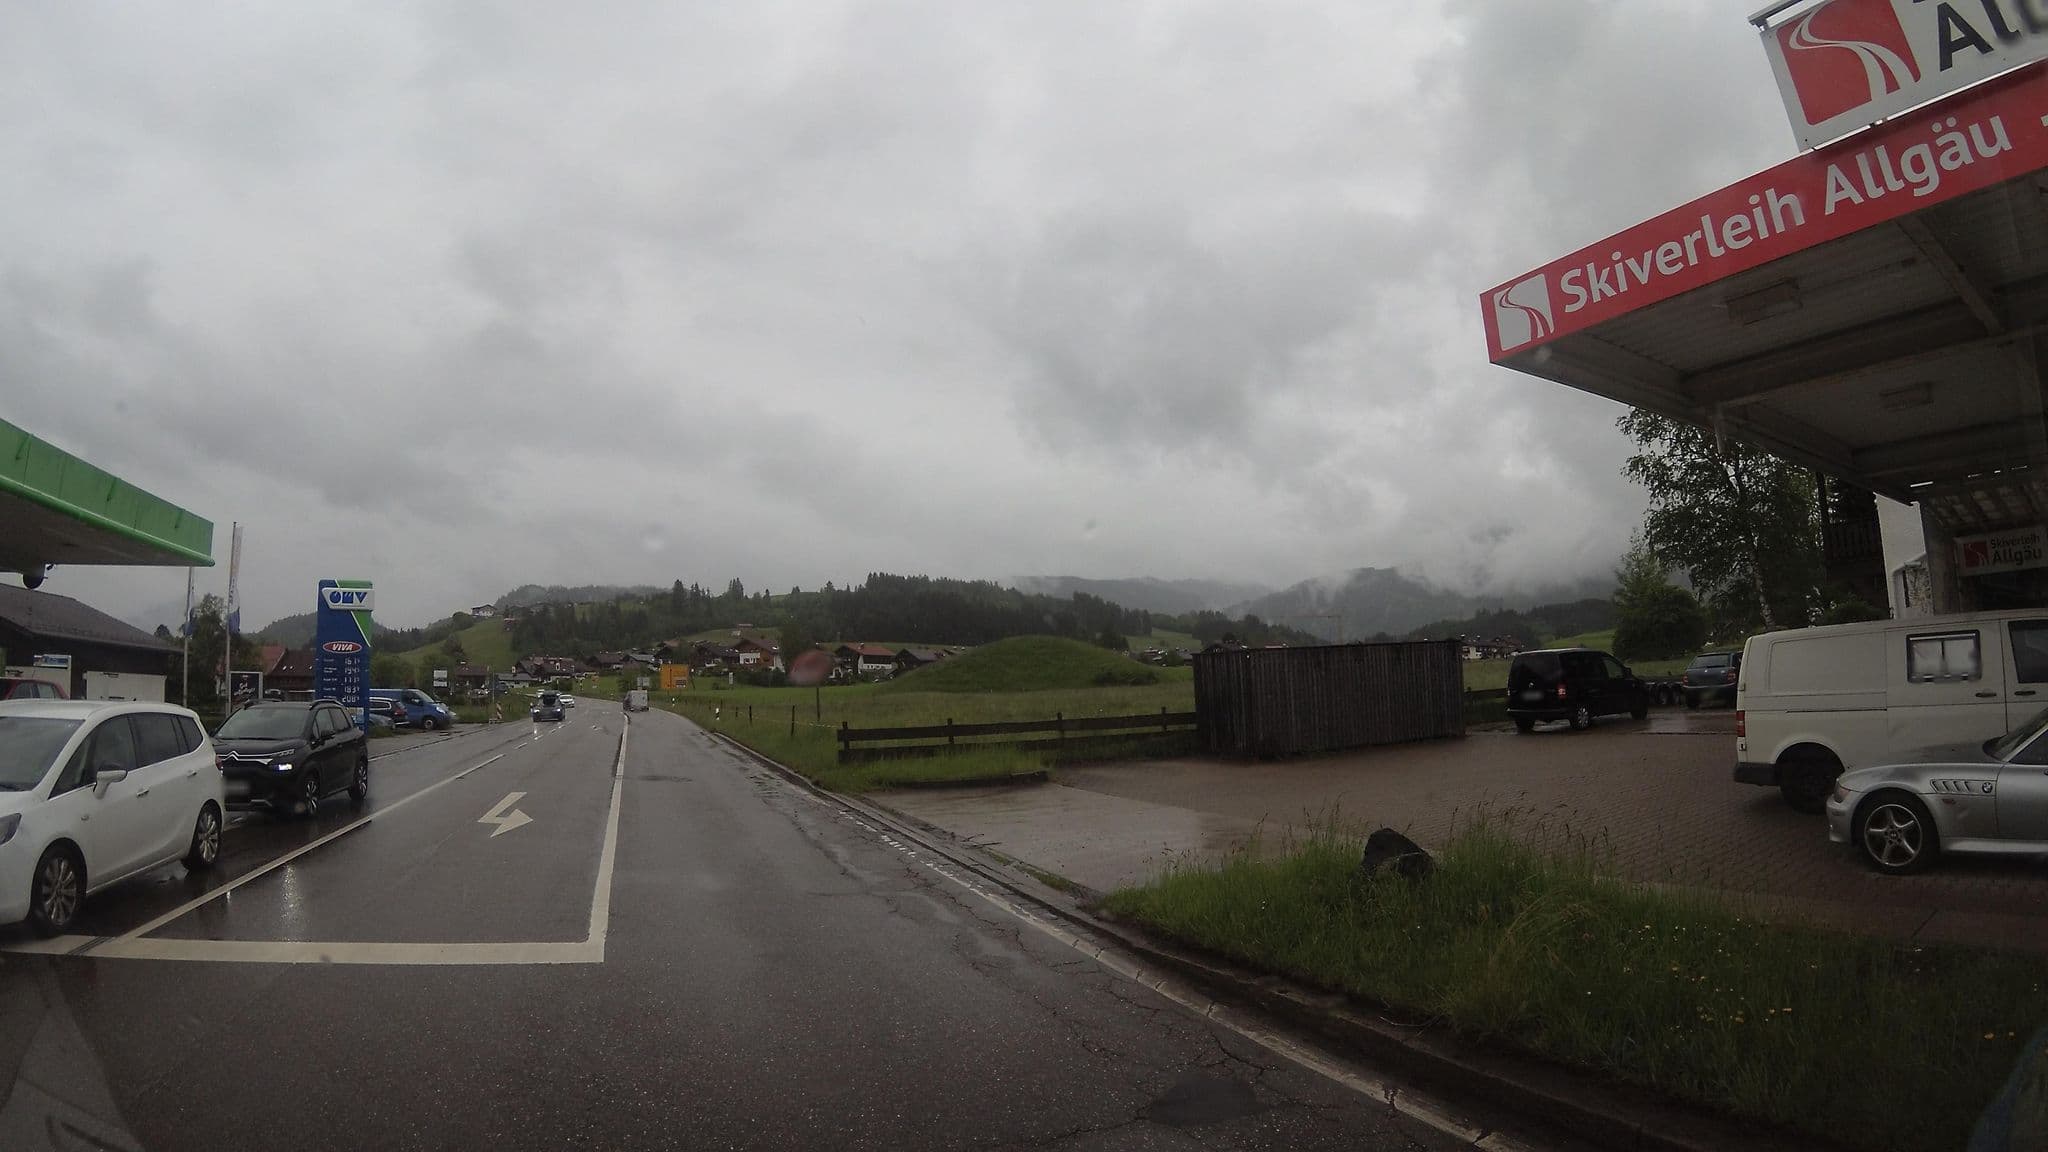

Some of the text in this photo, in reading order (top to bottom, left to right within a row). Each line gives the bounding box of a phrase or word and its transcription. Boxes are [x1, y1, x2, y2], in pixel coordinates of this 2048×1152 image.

[1559, 114, 2013, 313] Skiverleih Allgäu
[1992, 545, 2042, 566] Allgäu
[329, 591, 367, 604] OMV
[332, 643, 354, 651] VIVA
